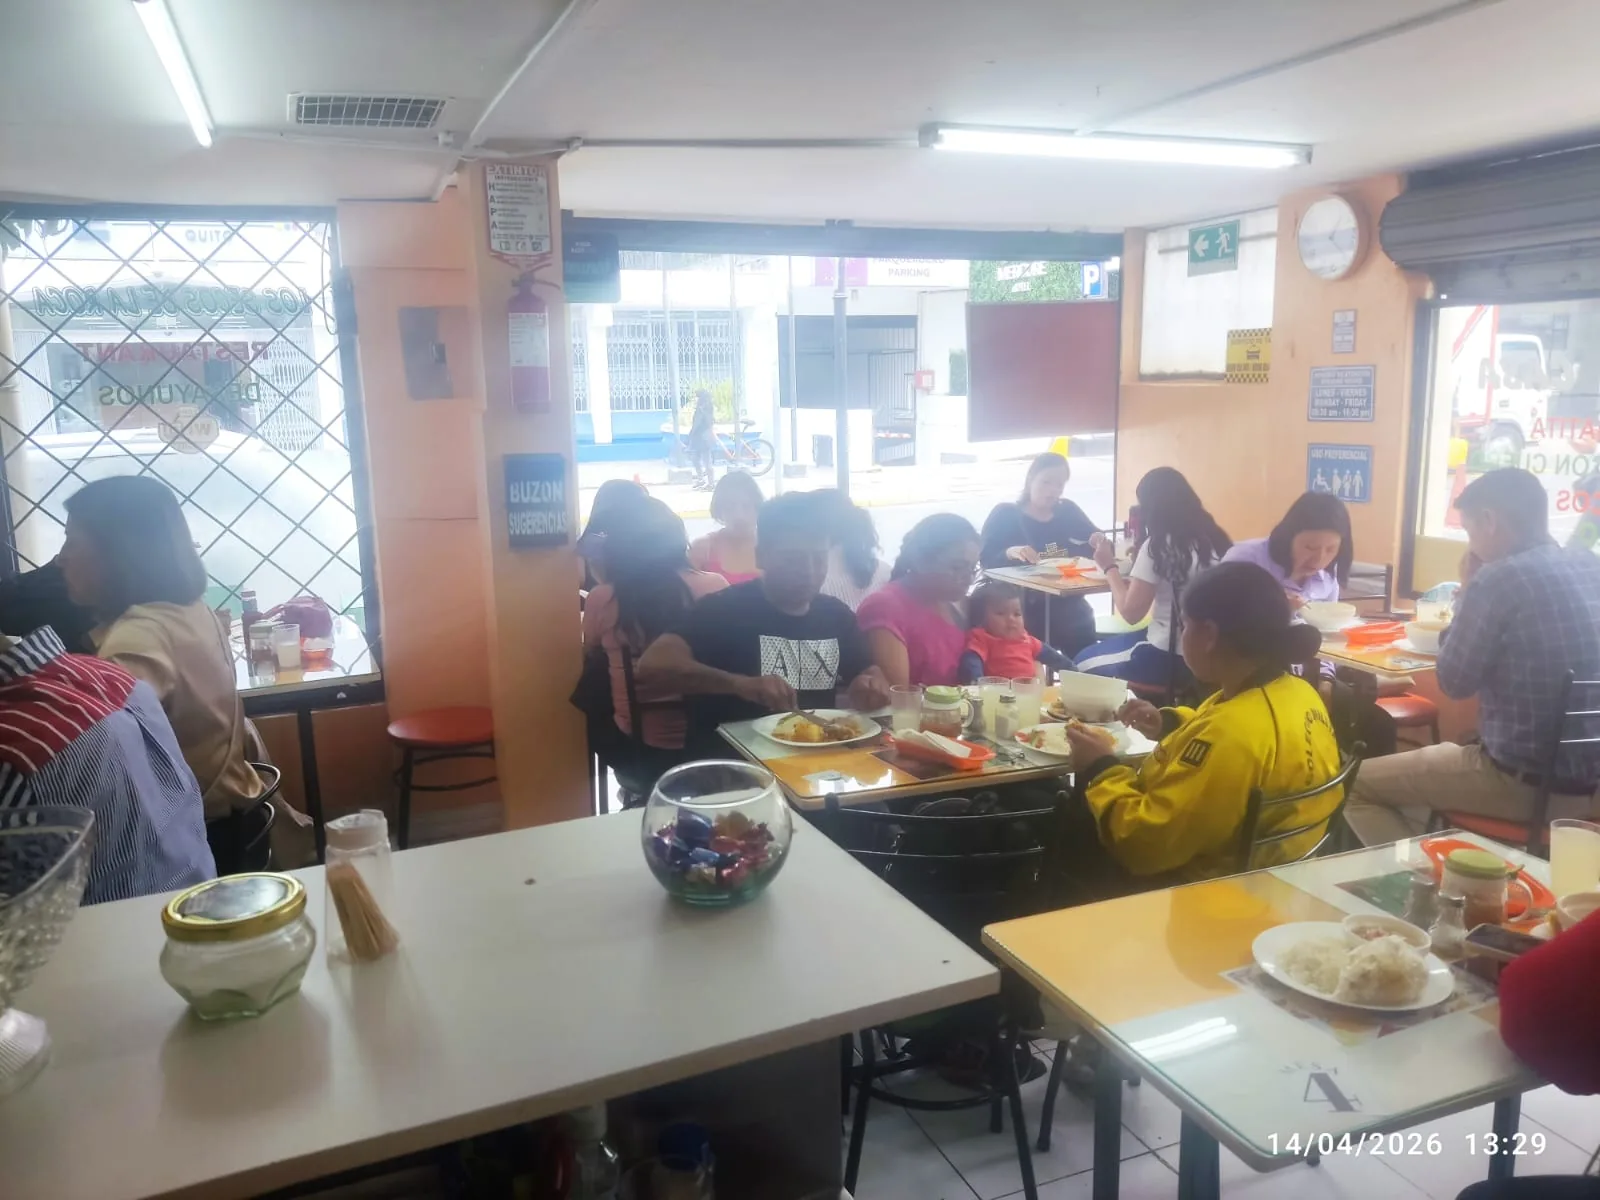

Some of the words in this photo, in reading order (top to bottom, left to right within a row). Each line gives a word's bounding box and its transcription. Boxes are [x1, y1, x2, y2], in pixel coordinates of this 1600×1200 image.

[487, 165, 546, 177] EXTINTOR
[888, 267, 931, 278] PARKING
[1083, 264, 1101, 296] P
[510, 480, 563, 503] BUZON
[508, 510, 568, 536] SUGERENCIAS
